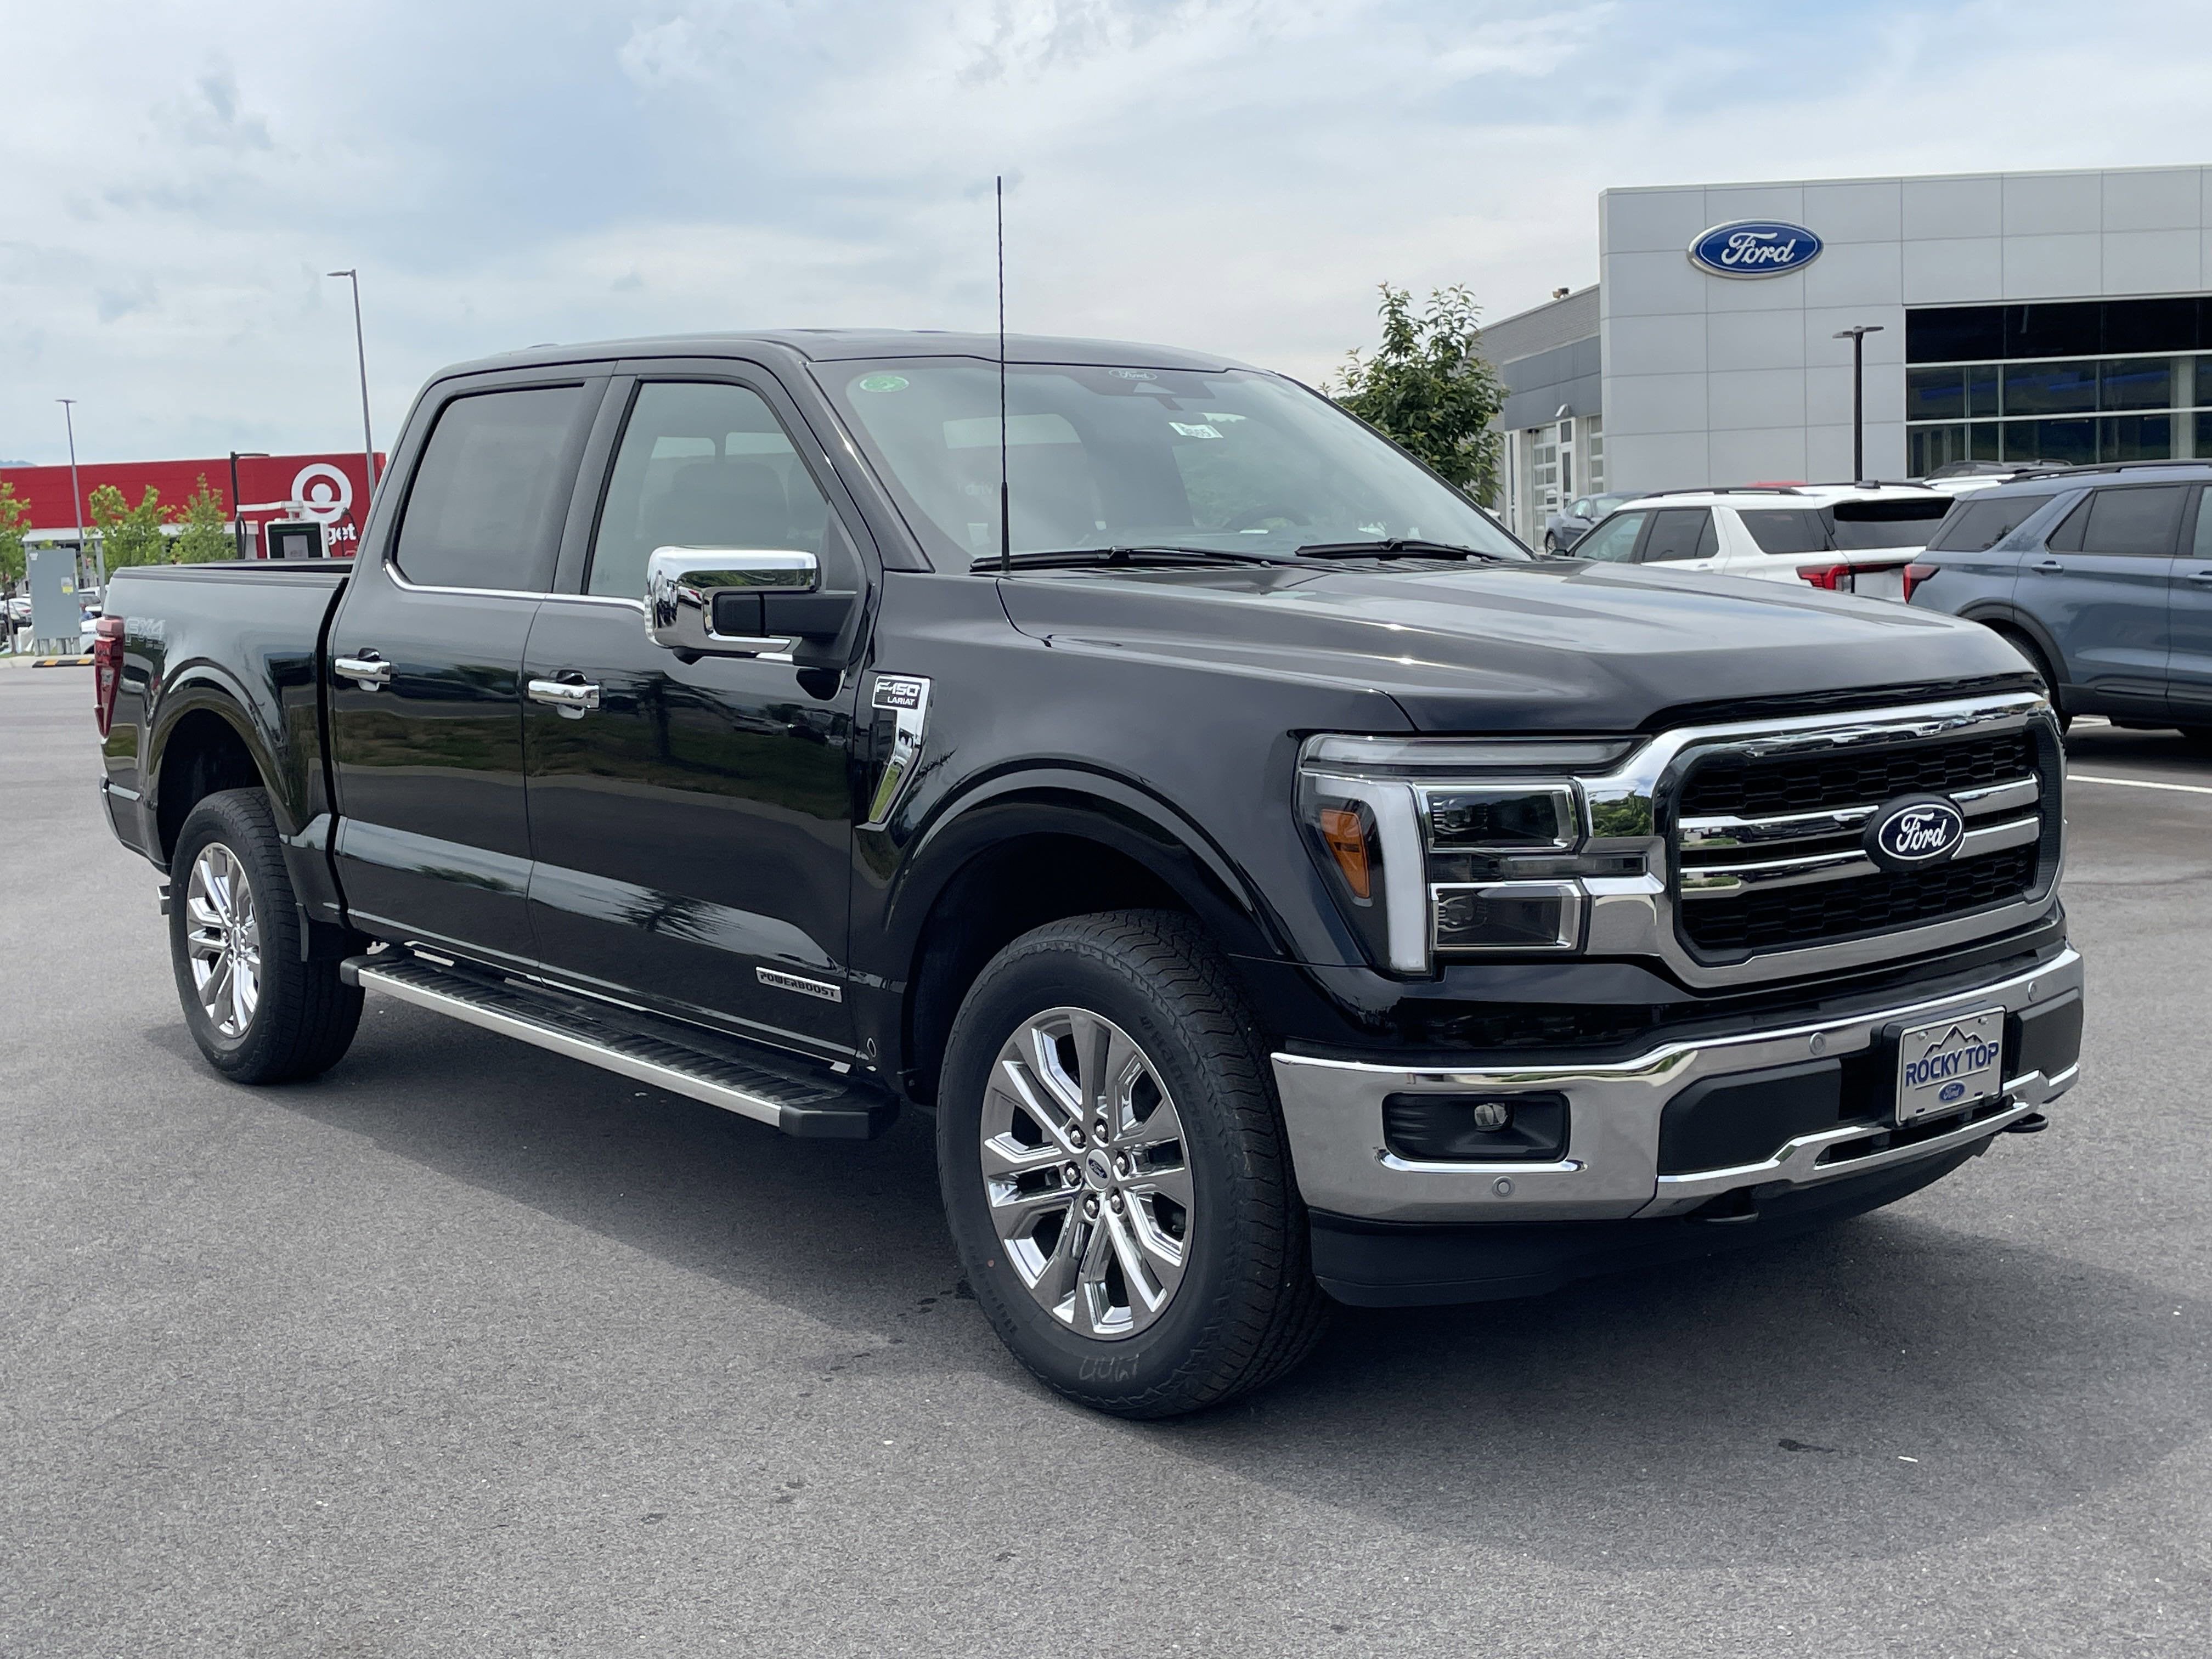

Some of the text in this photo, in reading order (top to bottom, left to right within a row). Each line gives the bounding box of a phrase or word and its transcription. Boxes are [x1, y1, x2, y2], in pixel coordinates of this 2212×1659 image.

[1722, 232, 1796, 264] Ford
[1119, 370, 1149, 379] Ford
[328, 523, 357, 546] get
[125, 617, 165, 646] FX4
[876, 682, 921, 697] F-150
[887, 696, 915, 706] LARIAT
[1896, 812, 1947, 852] Ford
[760, 972, 835, 997] POWERBOOST
[1905, 1040, 2000, 1087] ROCKY TOP
